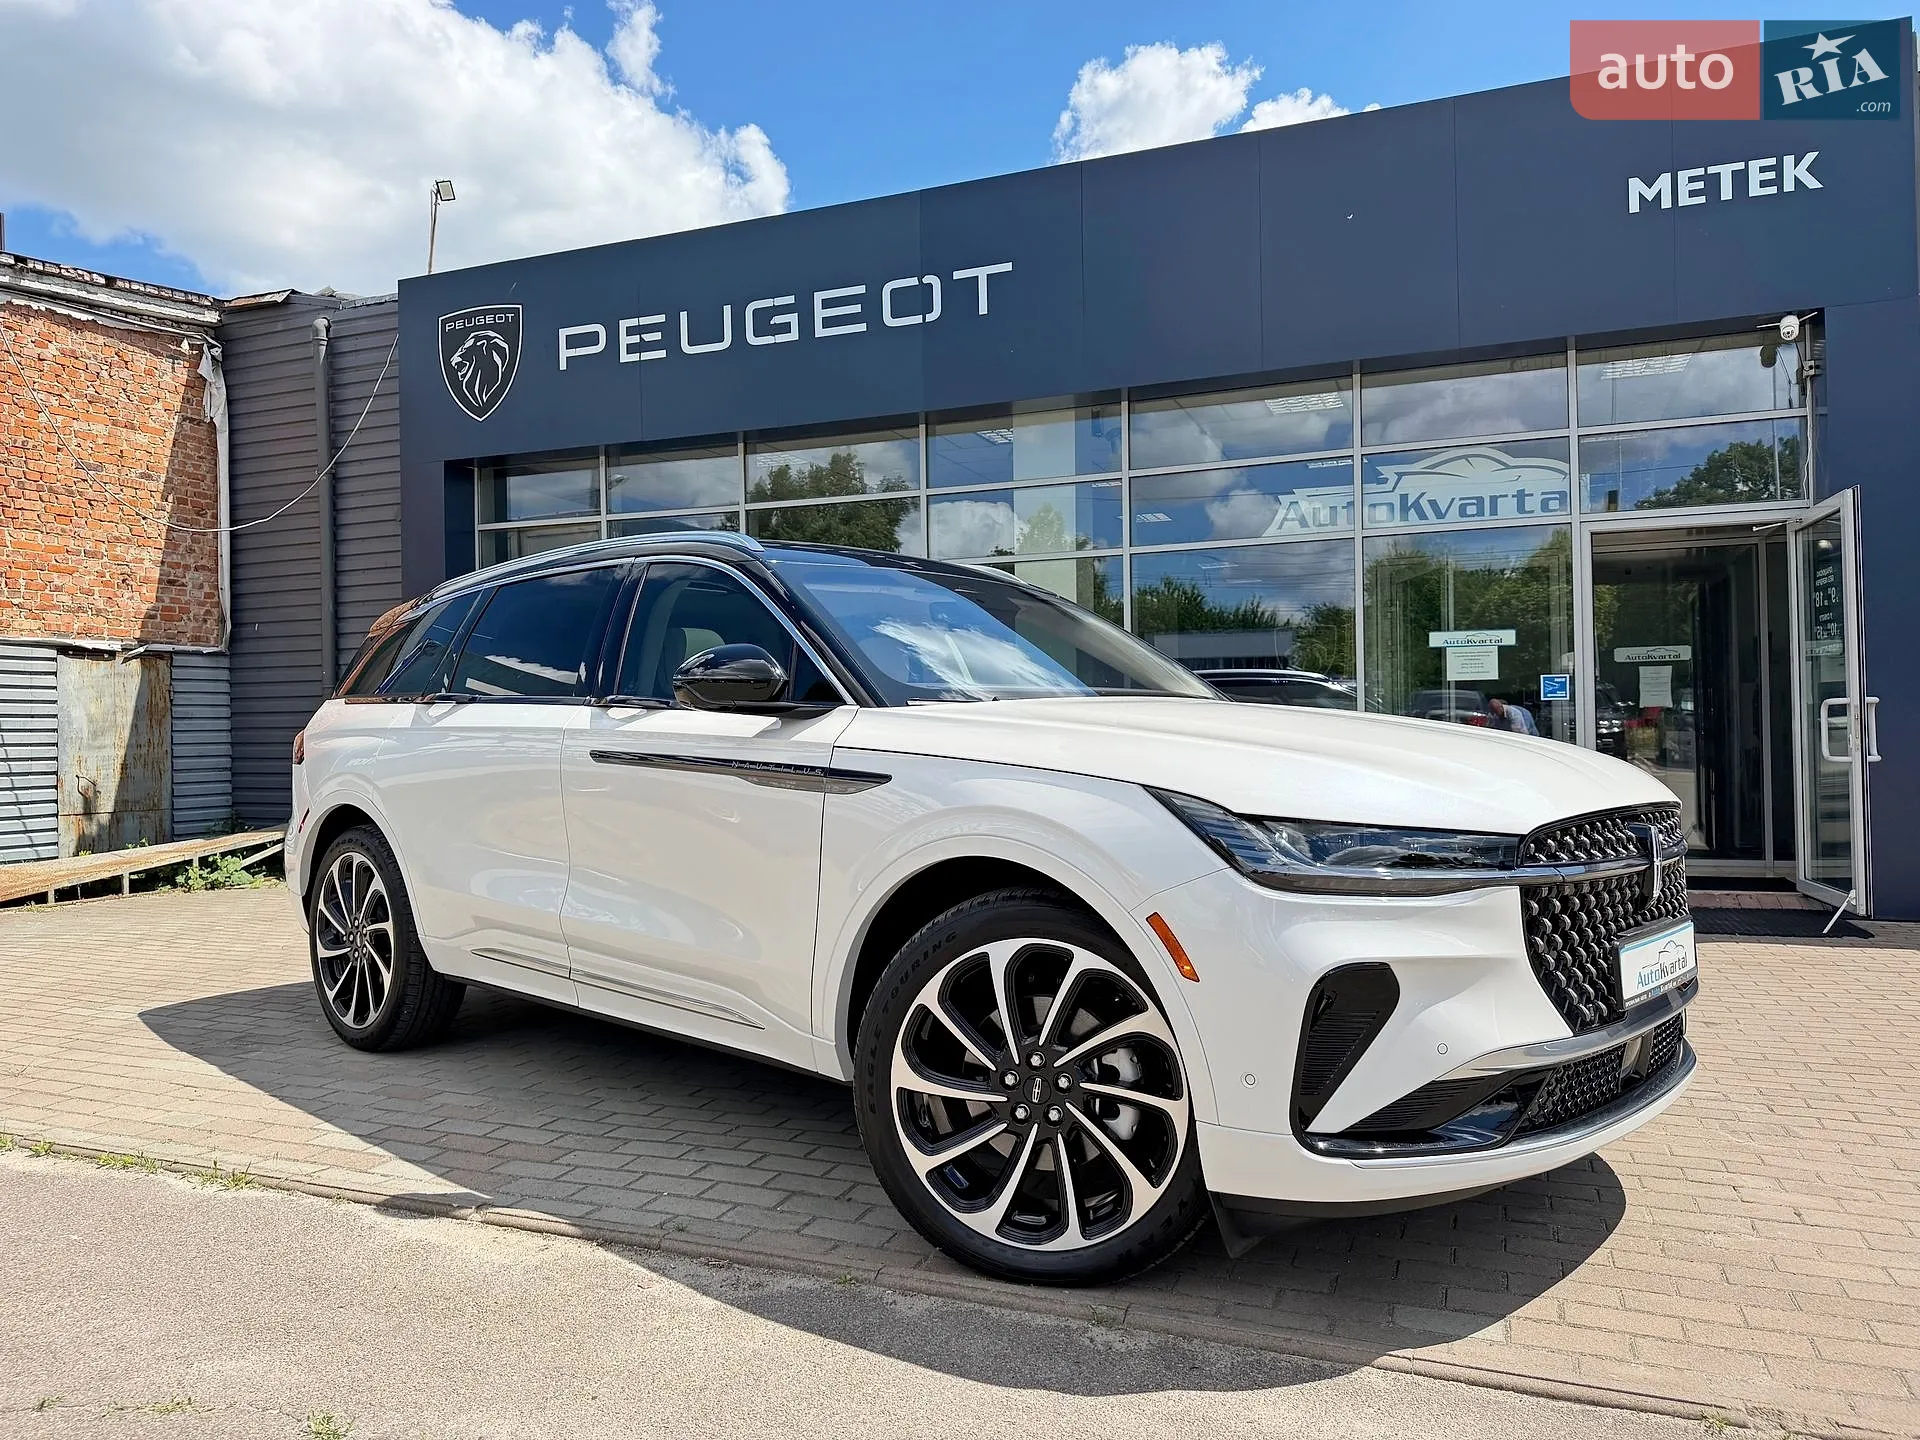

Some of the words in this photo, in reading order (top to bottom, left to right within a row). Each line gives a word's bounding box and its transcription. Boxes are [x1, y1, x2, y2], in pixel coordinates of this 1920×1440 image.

[1628, 151, 1825, 214] METEK
[445, 313, 515, 333] PEUGEOT
[558, 261, 1014, 371] PEUGEOT
[1276, 486, 1569, 531] AutoKvarta
[1442, 637, 1503, 645] AutoKvartal
[1625, 653, 1681, 661] AutoKvartal
[731, 760, 825, 776] NAUTILUS
[1636, 951, 1688, 991] AutoKvartal
